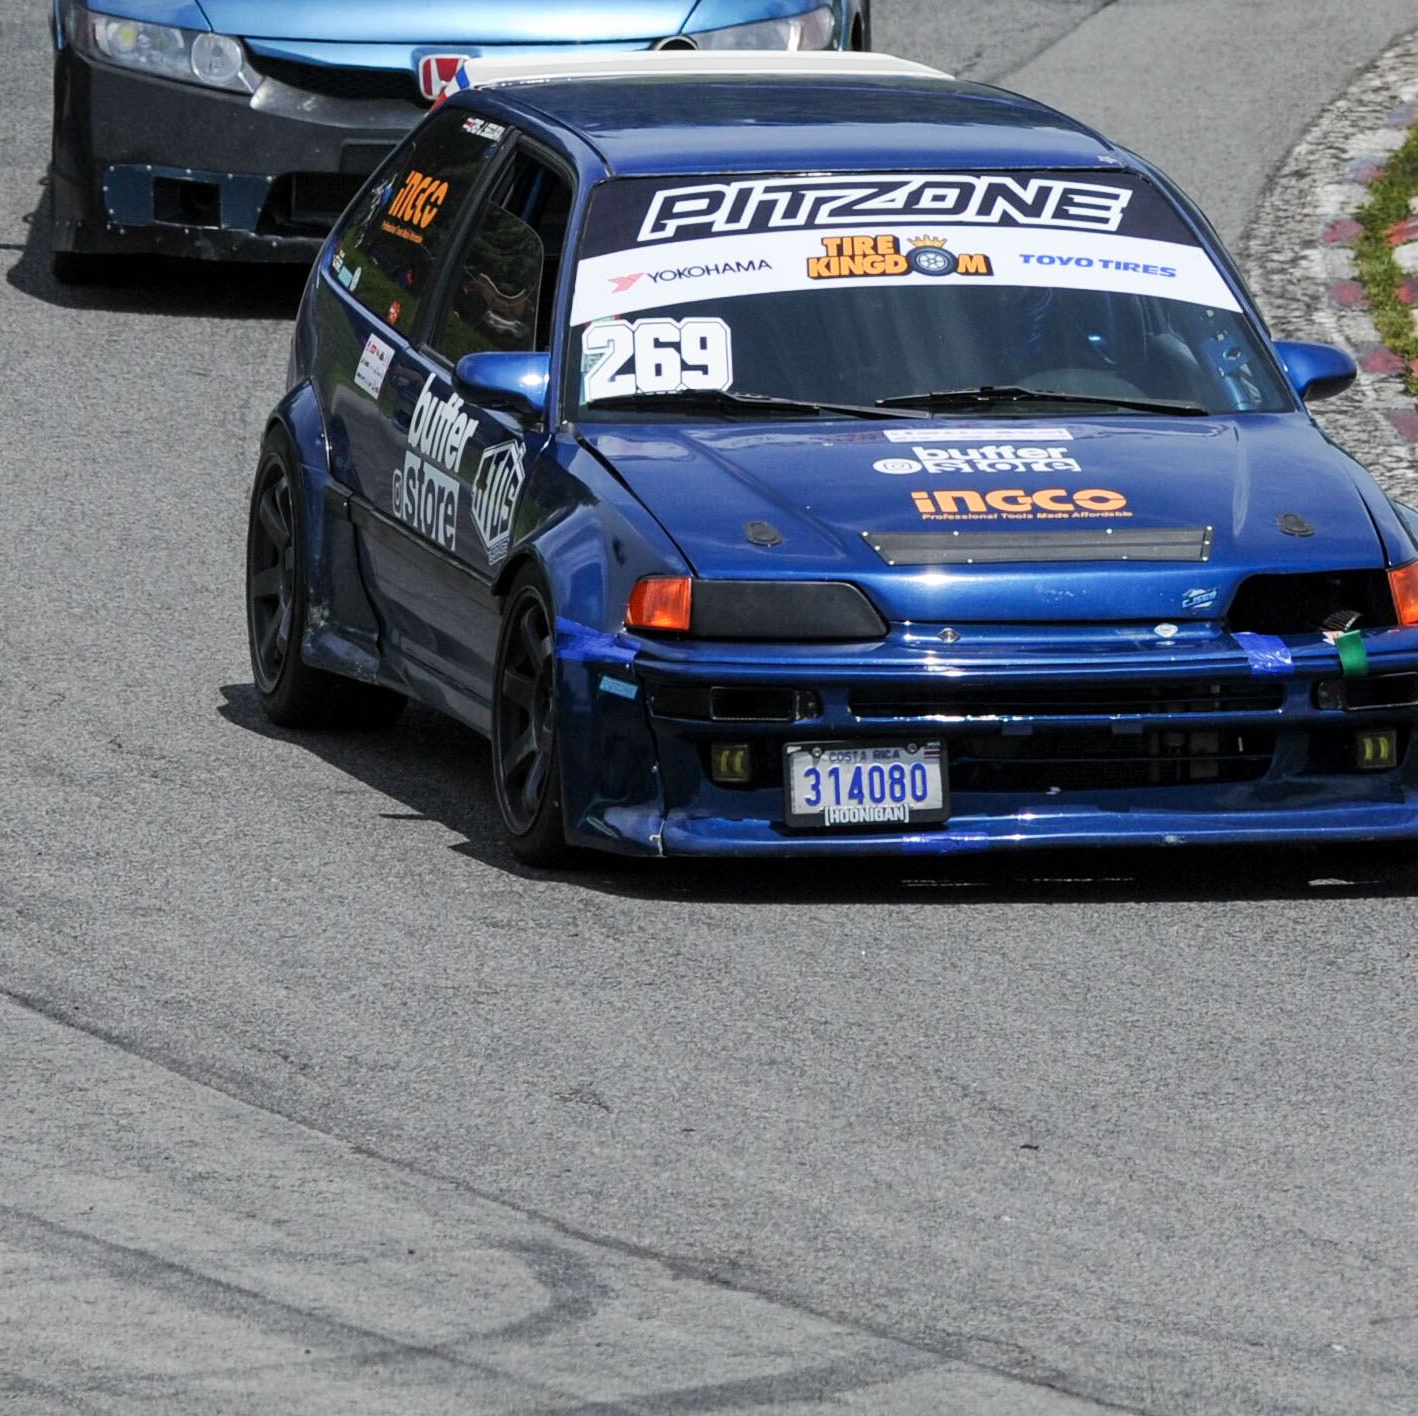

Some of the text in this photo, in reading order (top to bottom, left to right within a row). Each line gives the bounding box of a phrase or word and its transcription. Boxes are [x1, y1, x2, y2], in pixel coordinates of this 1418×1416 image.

[636, 175, 1134, 243] PITZONE
[821, 234, 900, 256] TIRE
[648, 258, 773, 284] YOKOHAMA
[1019, 254, 1094, 268] TOYO
[1098, 259, 1177, 278] TIRES
[582, 317, 733, 402] 269
[408, 372, 479, 474] buffer
[911, 445, 1069, 460] buffer
[922, 512, 998, 521] Professional
[1001, 512, 1033, 520] Tools
[1072, 510, 1134, 519] Affordable
[828, 749, 901, 762] COSTA RICA
[804, 762, 929, 807] 314080
